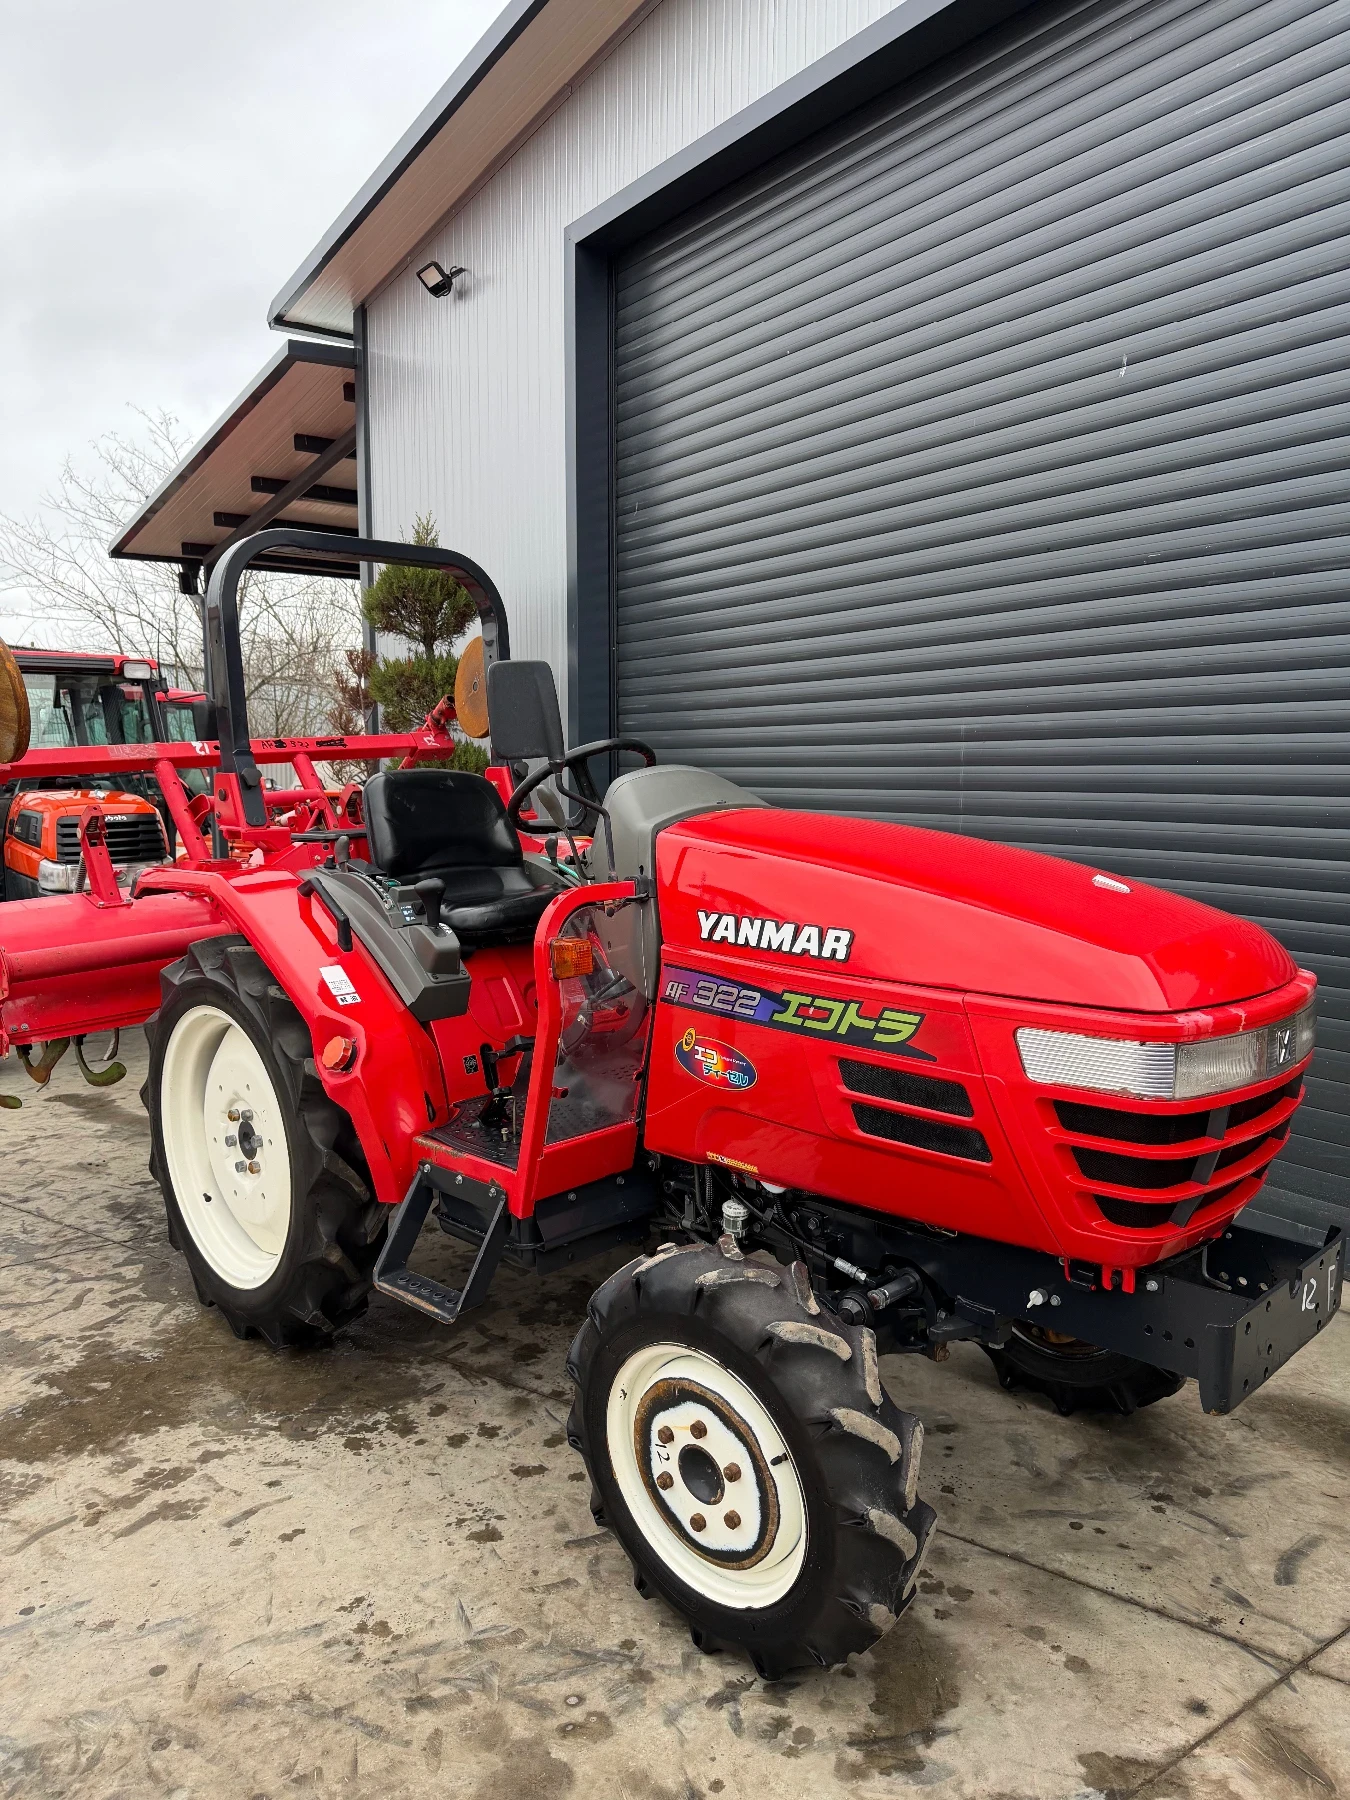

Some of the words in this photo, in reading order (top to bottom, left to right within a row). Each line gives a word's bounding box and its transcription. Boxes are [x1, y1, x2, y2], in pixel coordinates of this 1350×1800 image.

[697, 910, 854, 962] YANMAR
[665, 981, 690, 1002] AF
[693, 980, 761, 1016] 322
[771, 990, 922, 1043] エコトラ
[694, 1045, 718, 1066] エコ
[702, 1063, 749, 1087] ディーゼル
[1302, 1277, 1317, 1312] 12
[655, 1443, 671, 1465] 12
